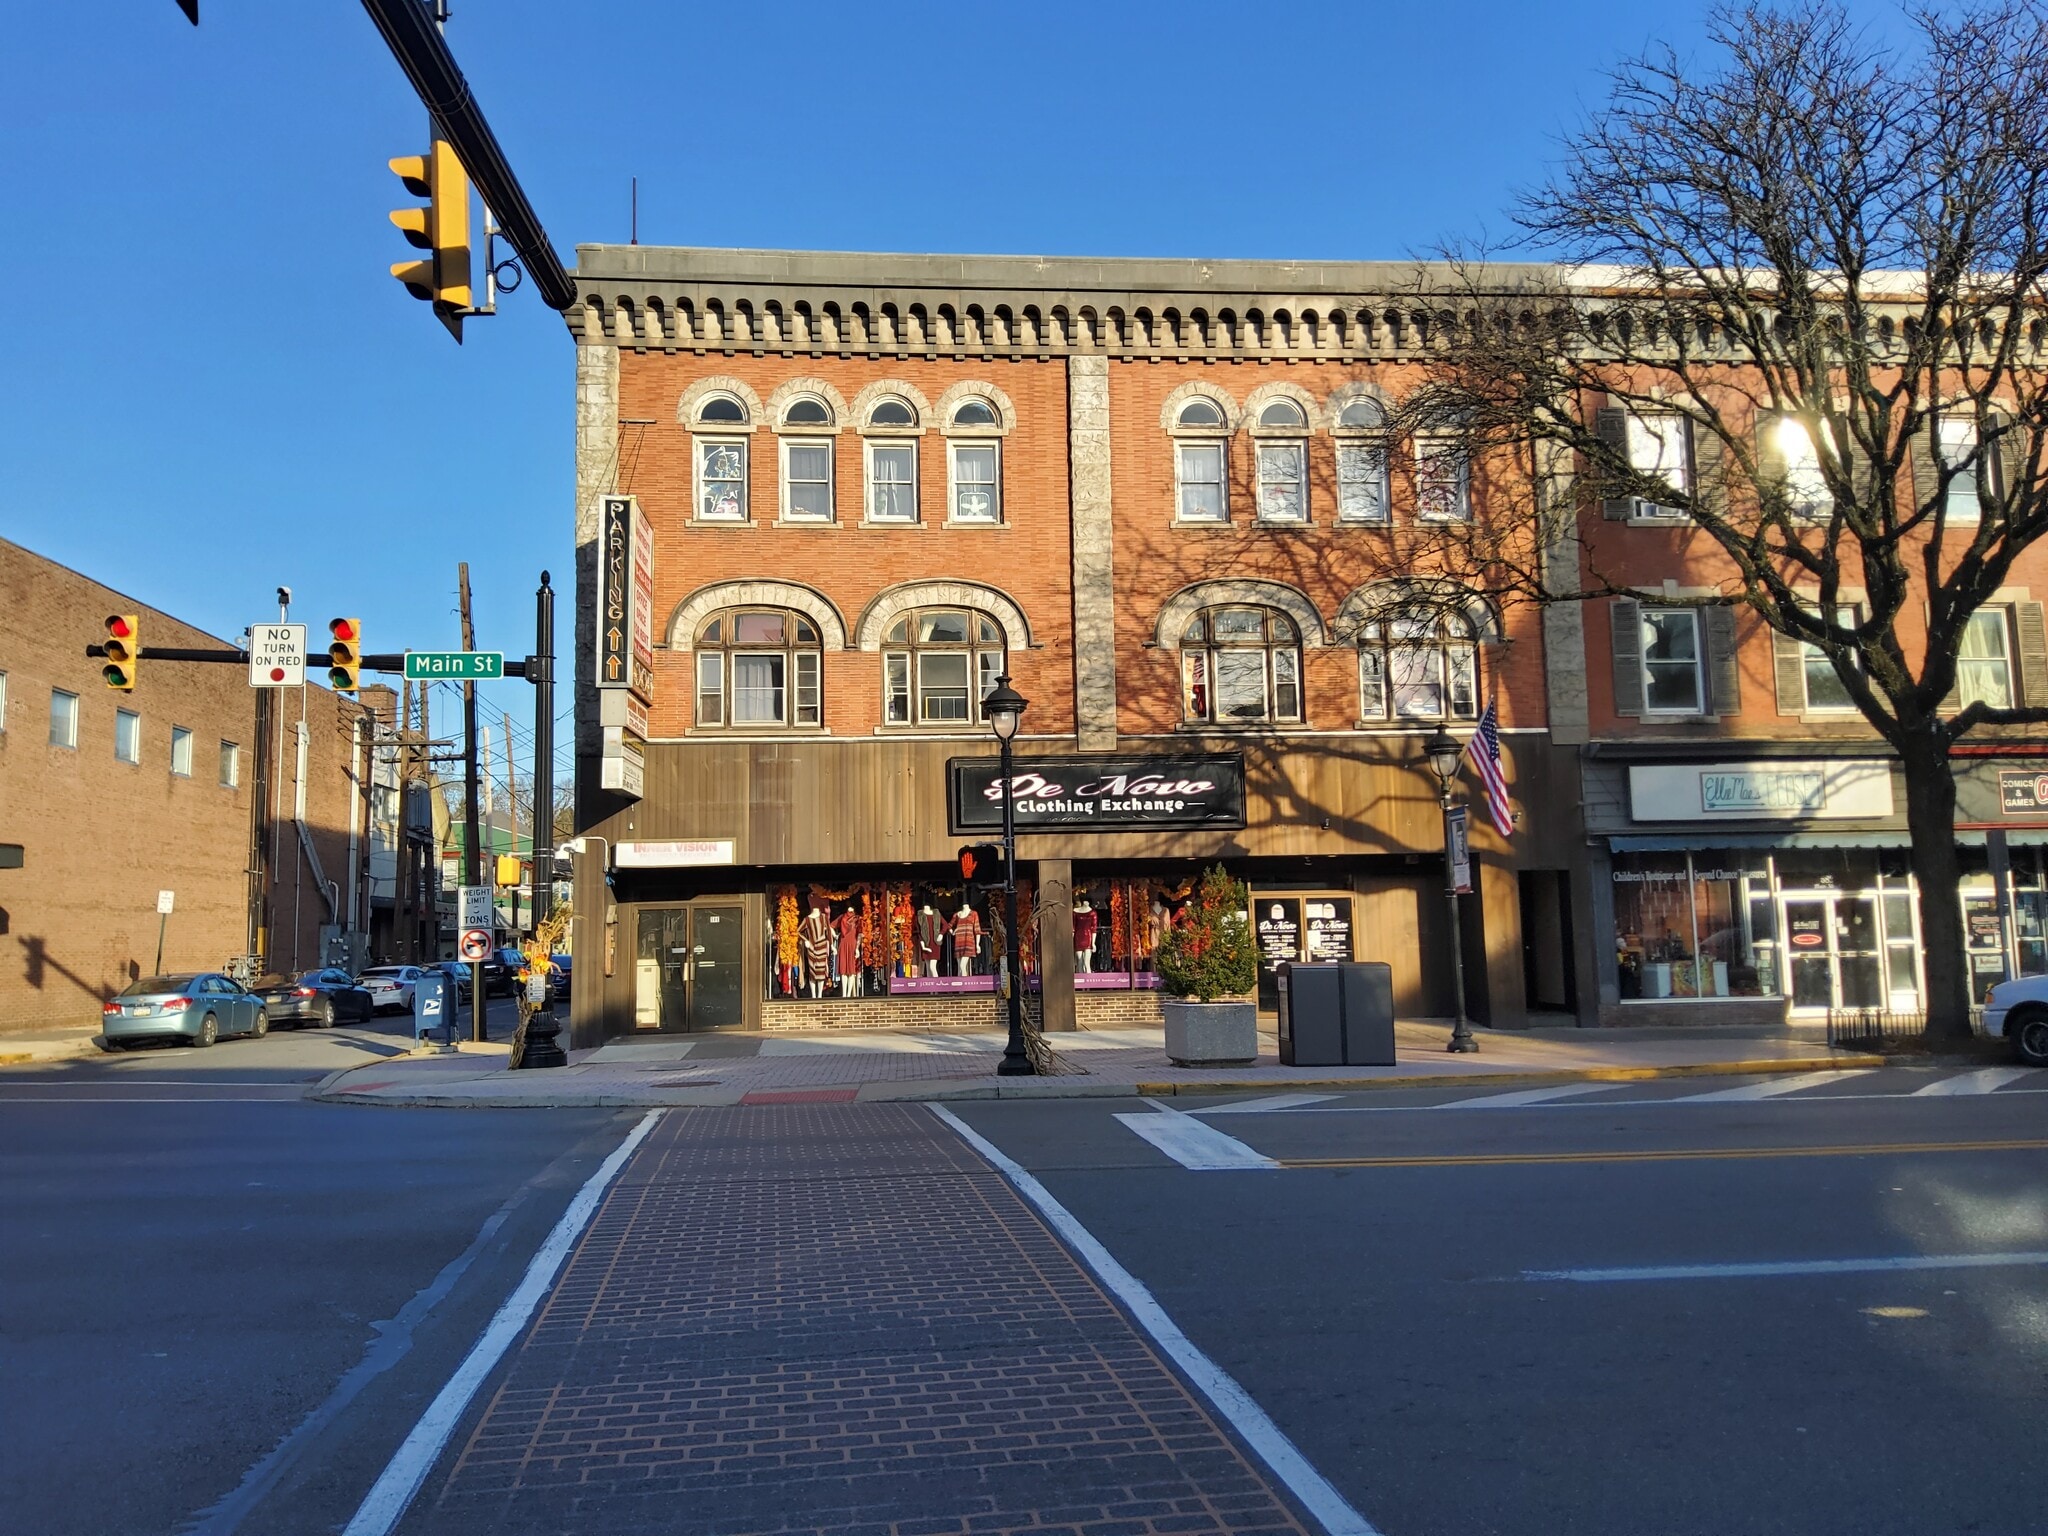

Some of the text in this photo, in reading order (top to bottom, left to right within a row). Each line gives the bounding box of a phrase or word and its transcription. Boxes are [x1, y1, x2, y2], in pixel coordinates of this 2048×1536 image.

[608, 502, 625, 620] PARKING
[267, 629, 291, 641] NO
[263, 644, 295, 653] TURN
[255, 656, 300, 666] ON RED
[415, 656, 494, 672] Main St
[983, 773, 1216, 801] De Novo
[2002, 780, 2034, 788] COMICS
[1766, 774, 1822, 807] CLOSET
[2015, 789, 2022, 797] &
[1016, 799, 1185, 814] Clothing Exchange
[2004, 798, 2035, 807] GAMES
[675, 841, 718, 852] VISION
[1612, 871, 1645, 882] Children's
[1674, 869, 1687, 880] and
[1694, 869, 1716, 881] Second
[1716, 869, 1738, 880] Chance
[463, 888, 490, 897] WEIGHT
[466, 896, 486, 905] LIMIT
[464, 915, 489, 924] TONS
[1311, 919, 1349, 930] De Novo
[1259, 920, 1297, 930] De Novo
